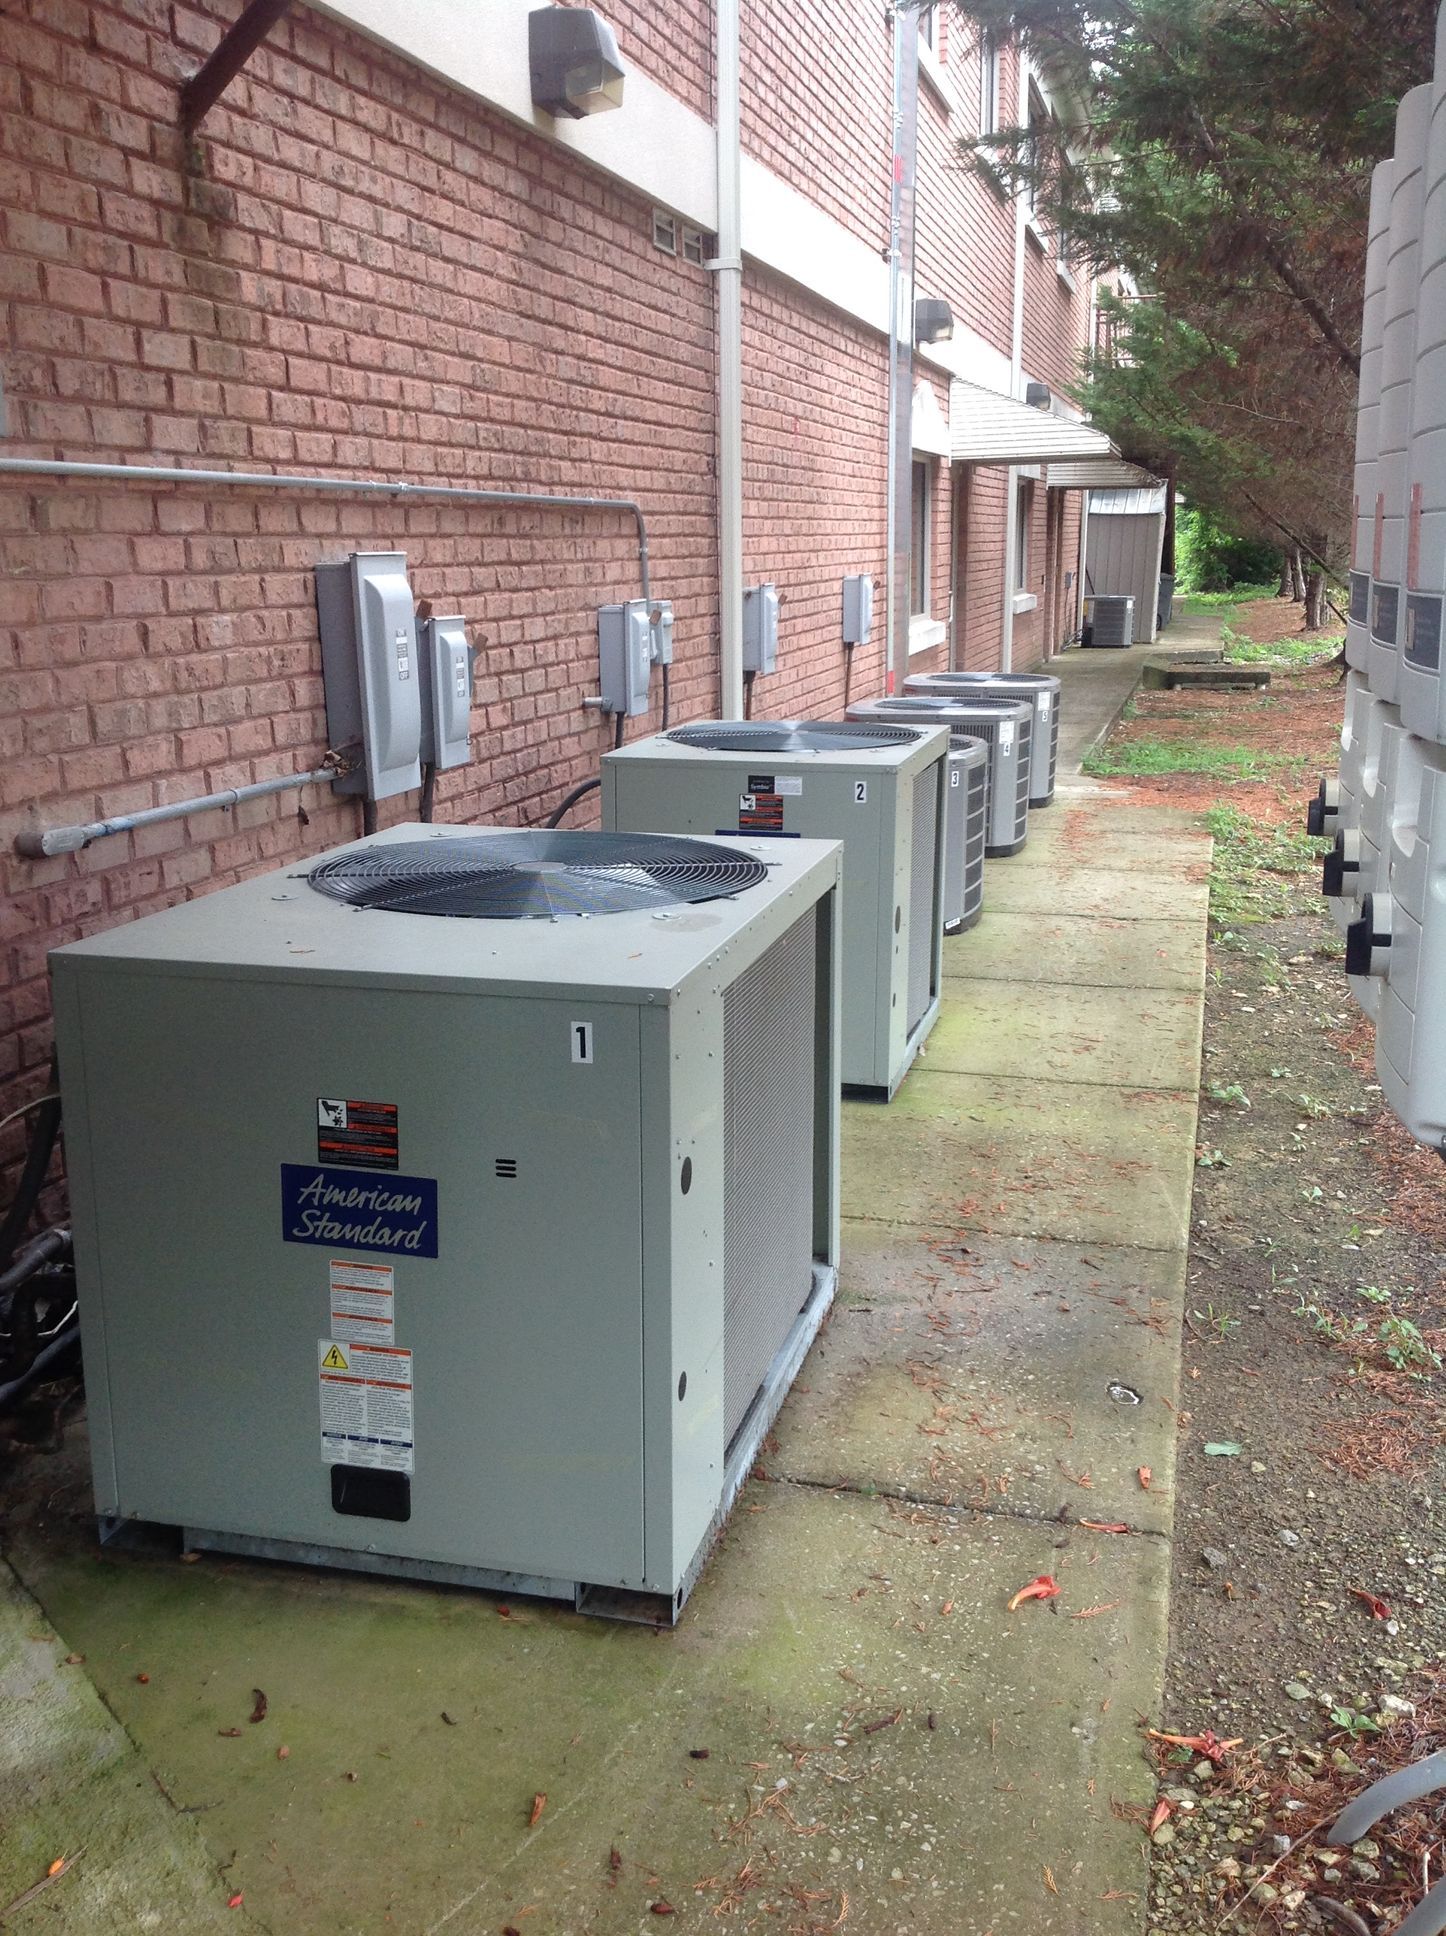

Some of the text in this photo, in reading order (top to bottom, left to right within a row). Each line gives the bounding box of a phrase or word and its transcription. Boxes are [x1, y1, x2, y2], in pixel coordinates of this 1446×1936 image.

[857, 783, 864, 801] 2
[576, 1027, 586, 1058] 1
[297, 1173, 422, 1215] American
[292, 1209, 427, 1250] Standard
